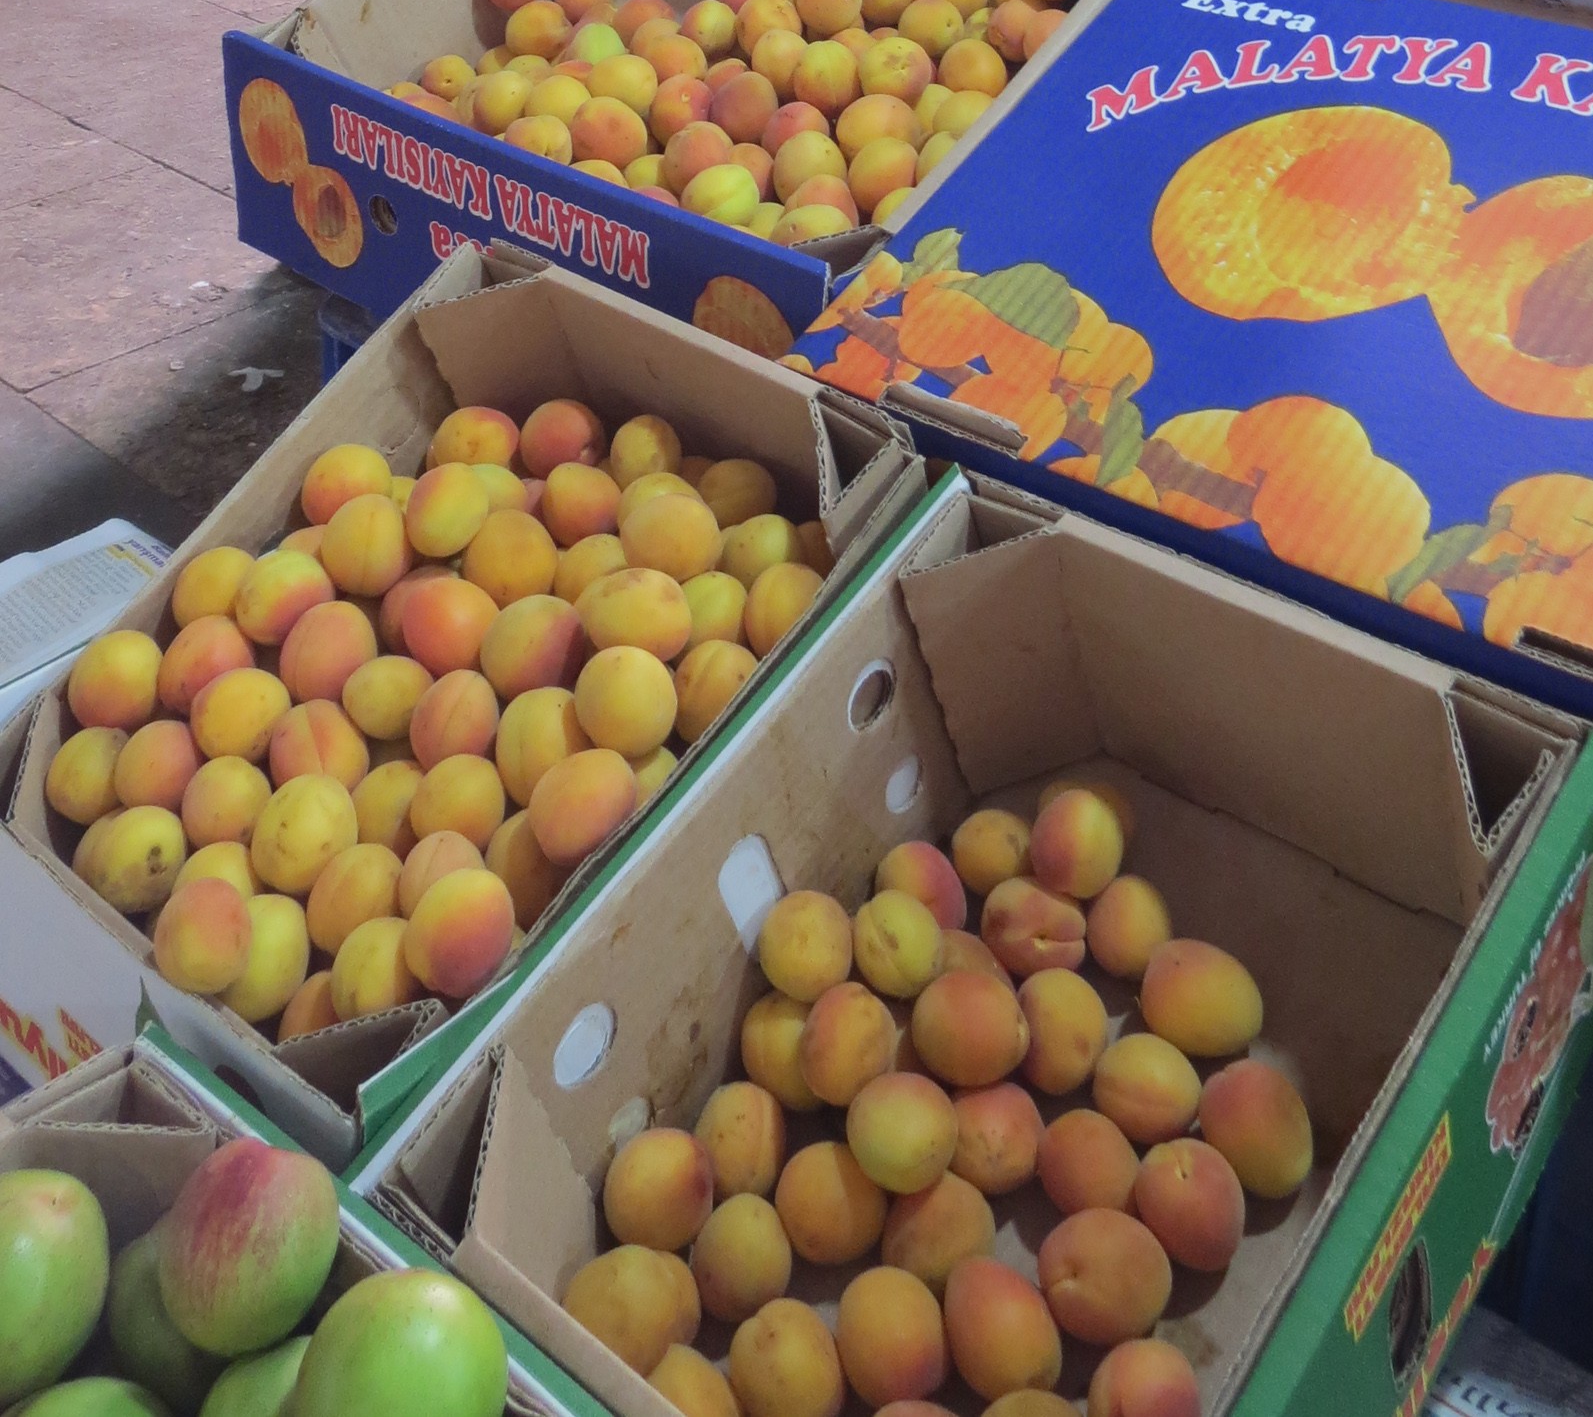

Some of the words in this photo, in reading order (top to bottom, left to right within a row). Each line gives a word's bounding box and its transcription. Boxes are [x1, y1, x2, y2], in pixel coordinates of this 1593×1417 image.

[1086, 34, 1492, 134] MALATYA
[329, 102, 493, 220] KAYISILARI
[494, 173, 651, 289] MALATYA
